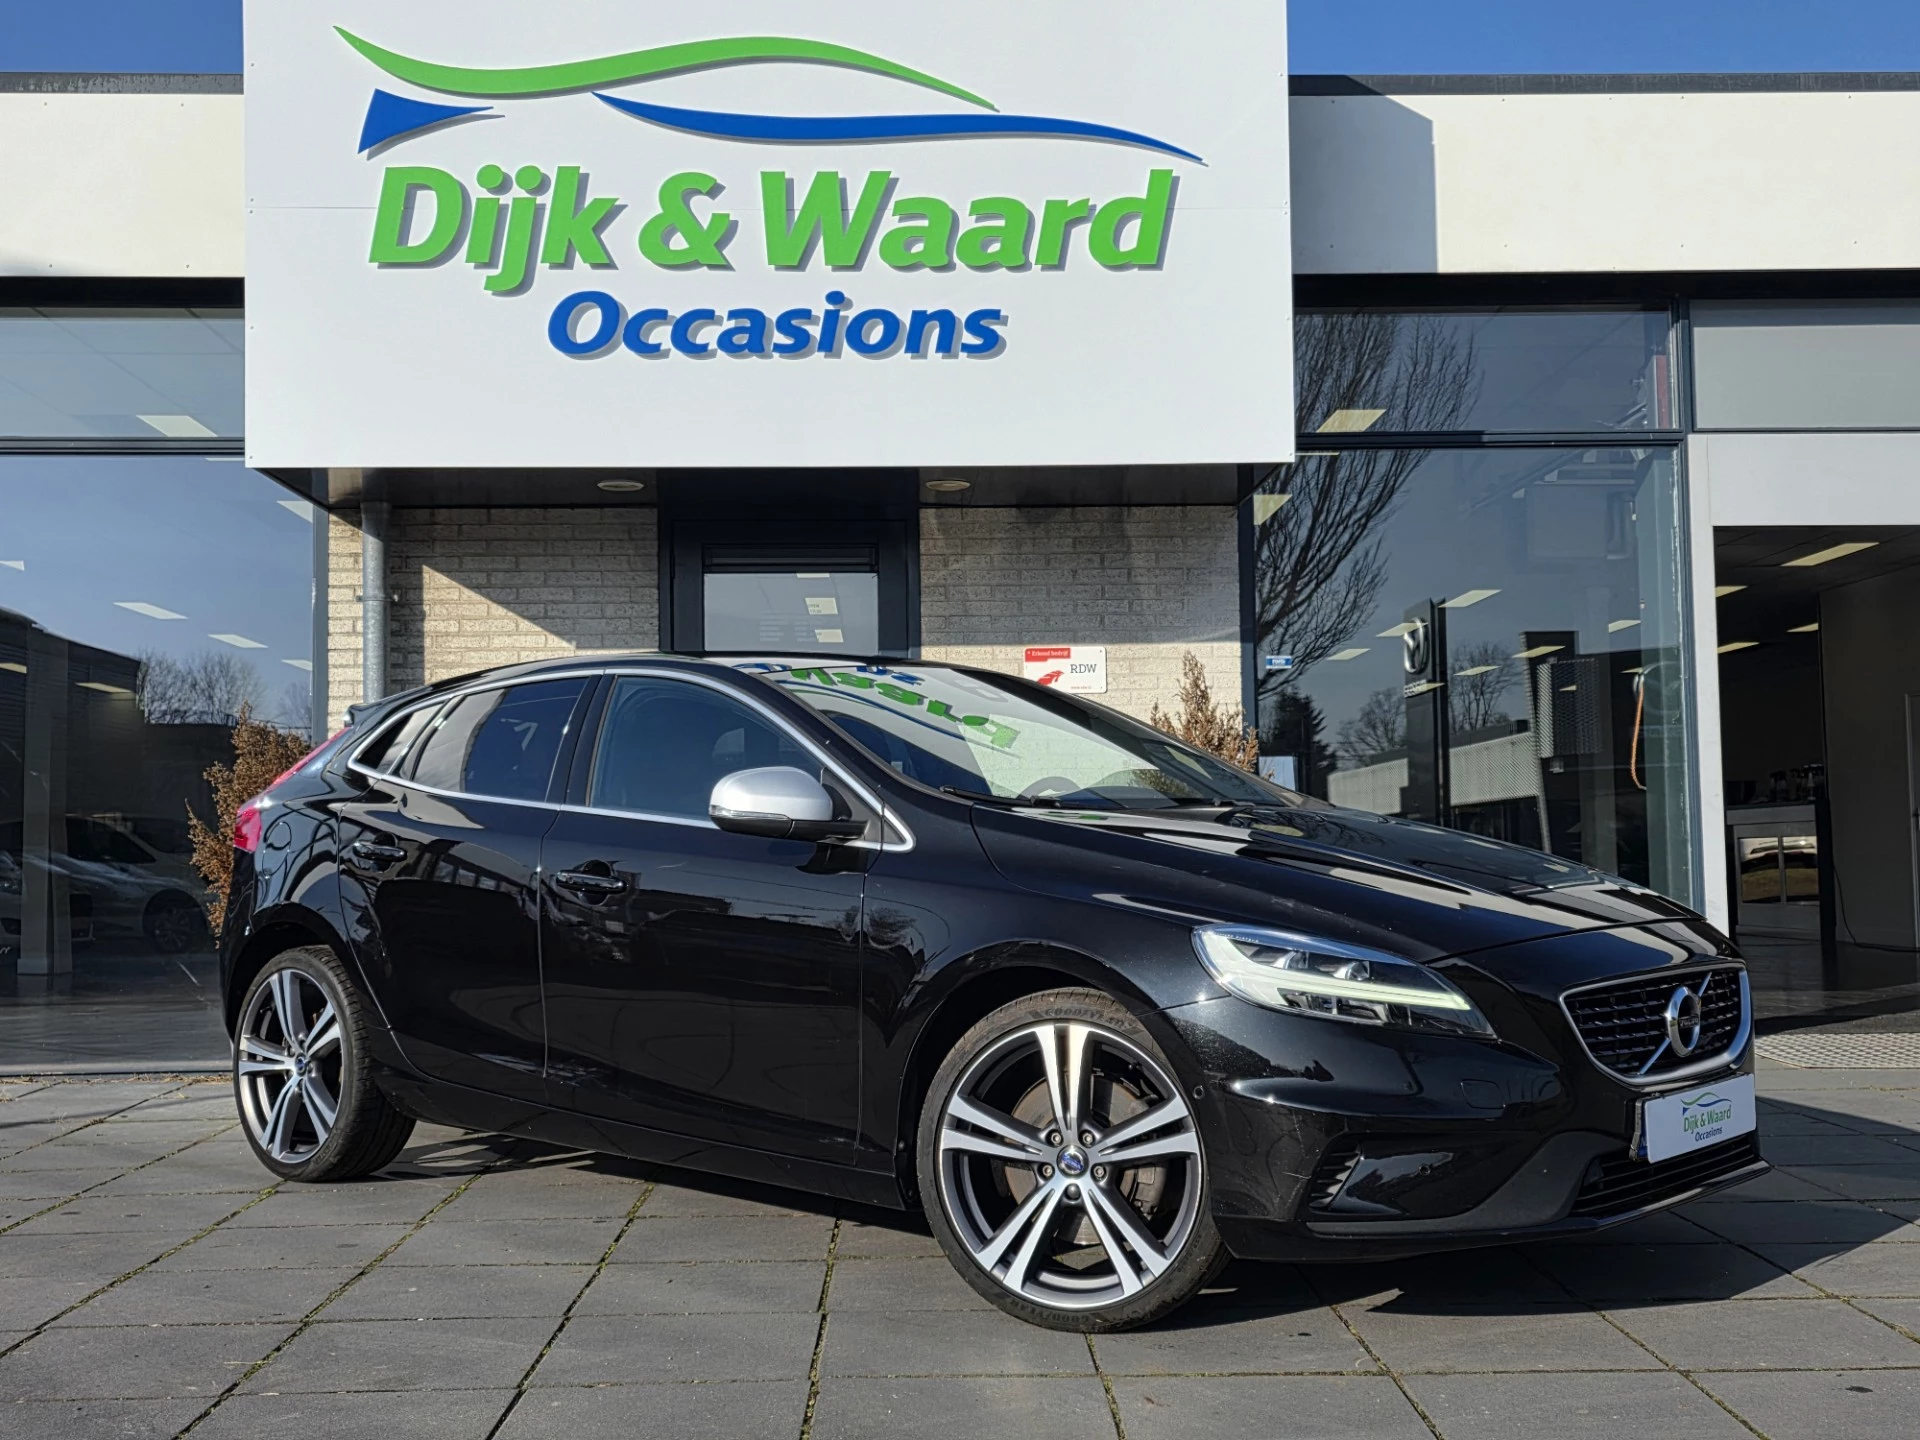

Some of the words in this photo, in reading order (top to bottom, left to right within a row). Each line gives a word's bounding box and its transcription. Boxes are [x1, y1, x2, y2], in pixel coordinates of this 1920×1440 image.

[370, 164, 617, 292] Dijk
[639, 172, 730, 266] &
[761, 169, 1174, 268] Waard
[548, 290, 1002, 355] Occasions
[1051, 650, 1069, 658] bedrijf
[1070, 663, 1097, 674] RDW
[1684, 1114, 1699, 1135] Dijk
[1700, 1112, 1706, 1128] &
[1707, 1104, 1732, 1125] Waard
[1695, 1126, 1723, 1142] Occasions
